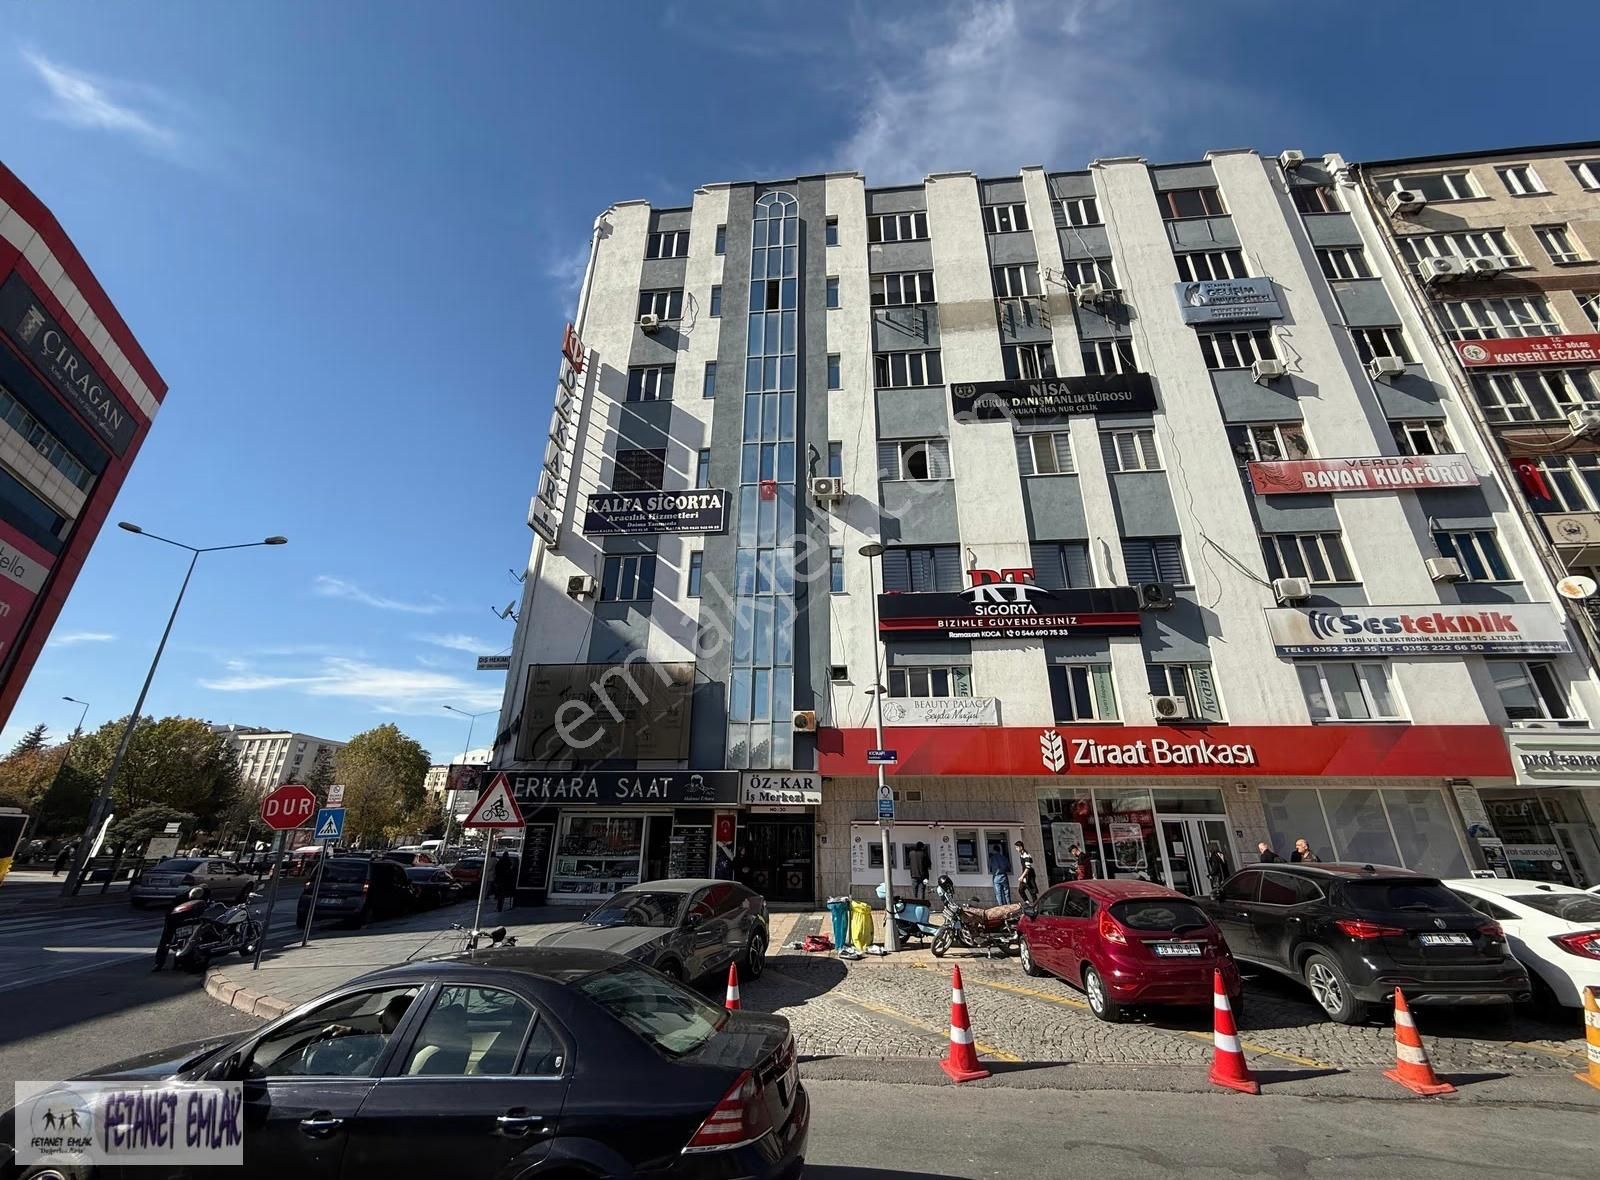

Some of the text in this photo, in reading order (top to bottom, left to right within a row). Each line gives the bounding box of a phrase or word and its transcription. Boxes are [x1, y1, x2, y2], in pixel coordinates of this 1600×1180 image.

[1567, 341, 1591, 349] BÖLGE
[1494, 349, 1597, 363] KAYSERİ ECZACI
[1030, 382, 1071, 397] NİSA
[1012, 395, 1085, 408] DANIŞMANLIK
[1088, 391, 1133, 403] BÜROSU
[1059, 405, 1075, 413] NUR
[1344, 457, 1415, 467] VERDA
[1302, 462, 1469, 488] BAYAN KUAFÖRÜ
[587, 493, 722, 514] KALFA SİGORTA
[967, 567, 1036, 603] RT
[1339, 611, 1519, 635] Sesteknik
[981, 630, 1001, 638] KOCA
[1402, 644, 1430, 652] 0352
[1197, 668, 1217, 713] MEDAY
[914, 700, 951, 709] BEAUTY
[1071, 738, 1255, 764] Ziraat Bankası
[512, 777, 673, 798] ERKARA SAAT
[745, 789, 805, 803] İş Merkezi
[266, 798, 311, 817] DUR
